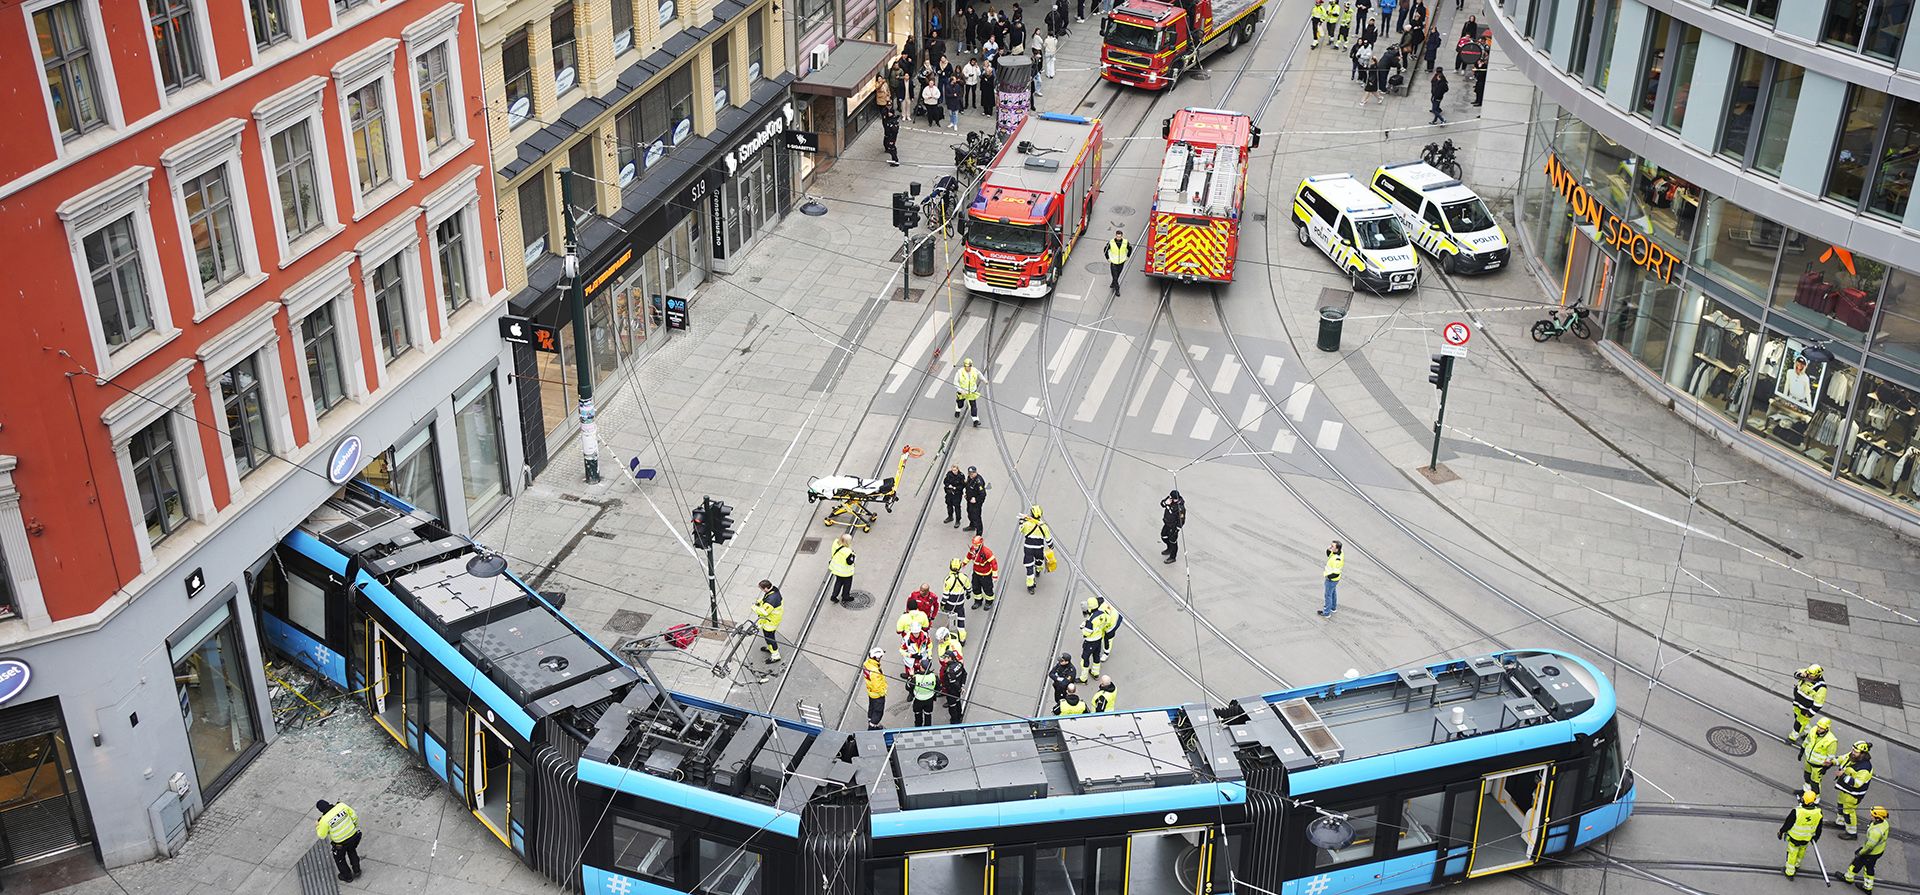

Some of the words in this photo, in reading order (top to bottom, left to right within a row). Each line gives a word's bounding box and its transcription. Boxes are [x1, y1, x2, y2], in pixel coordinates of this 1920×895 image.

[738, 116, 783, 164] iSmokeKing
[691, 179, 706, 202] S19
[1544, 151, 1603, 232] ANTON
[1606, 215, 1680, 284] SPORT
[1313, 225, 1329, 244] POLITI
[1472, 234, 1499, 246] POLITI
[990, 253, 1016, 261] SCANIA
[1380, 254, 1410, 263] POLITI
